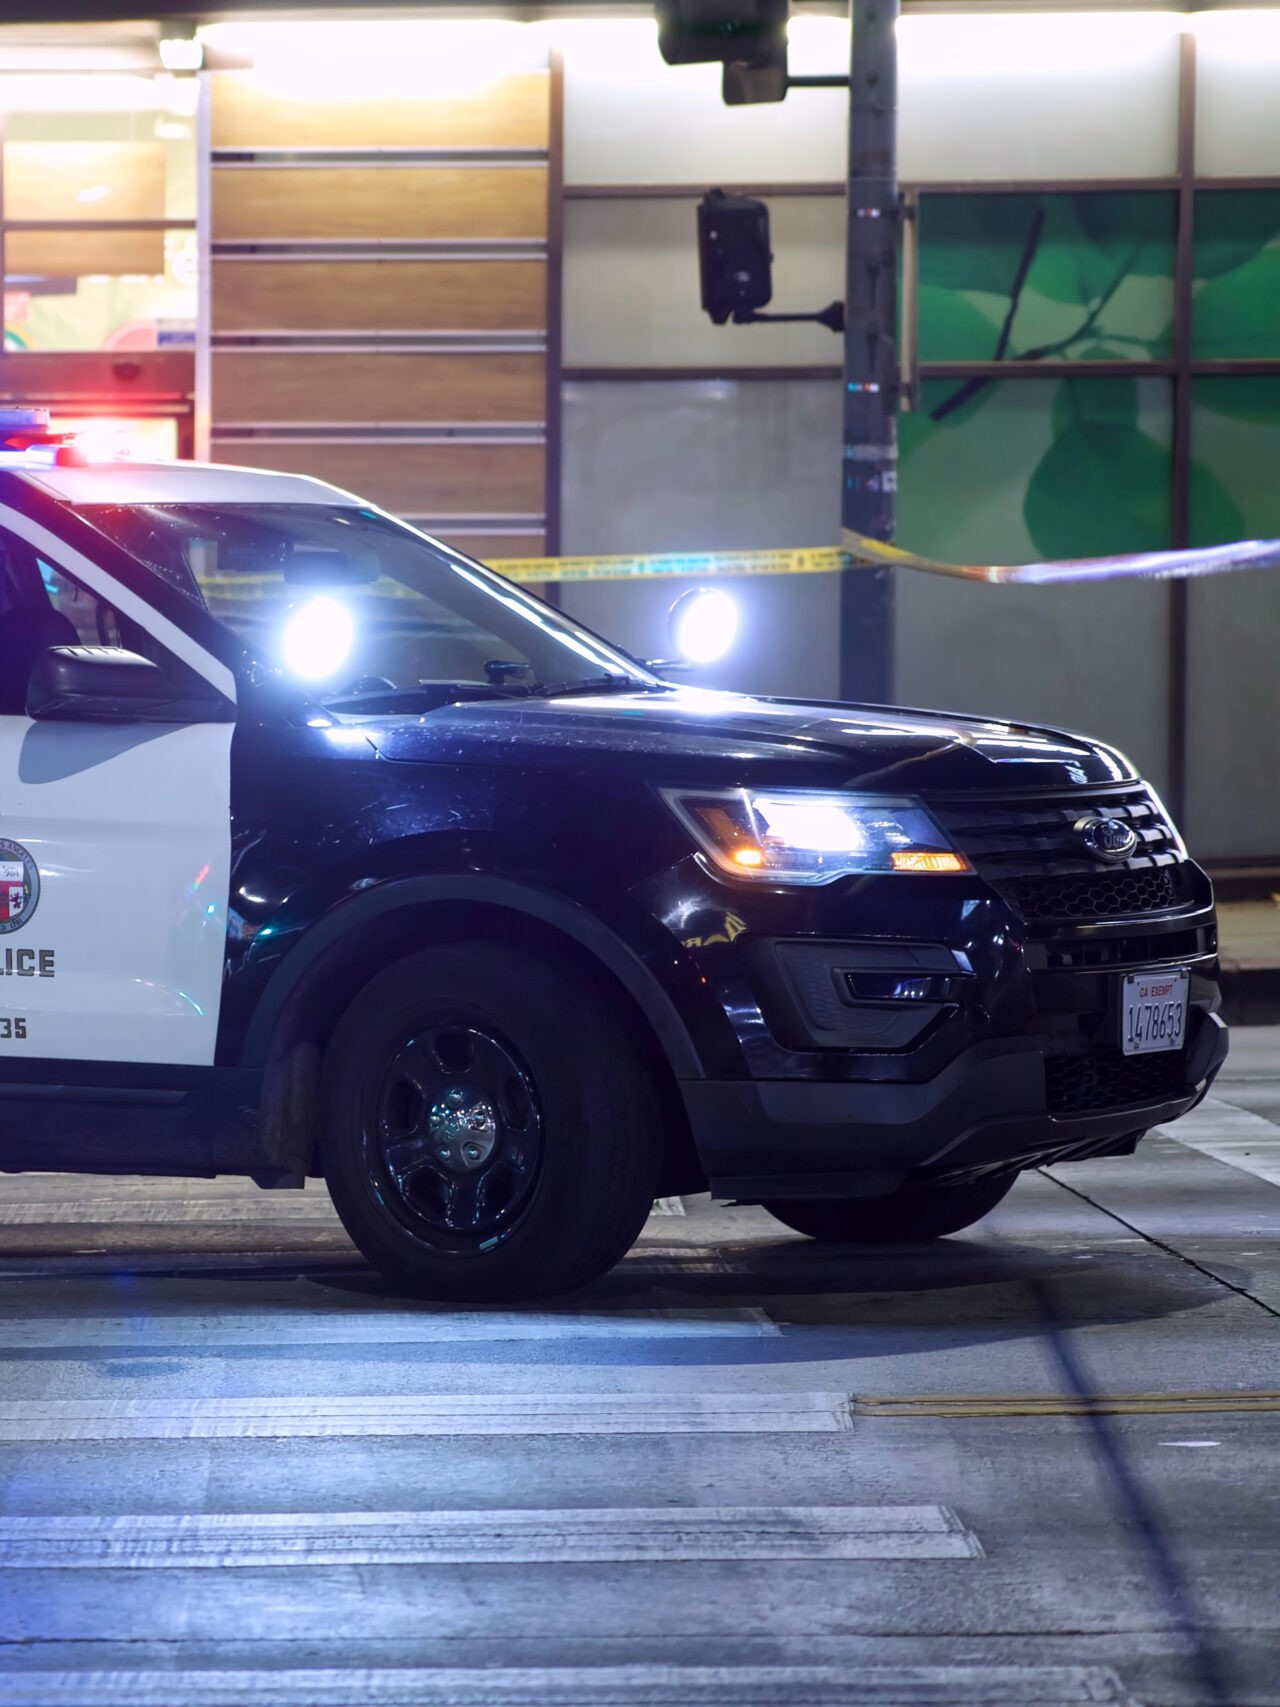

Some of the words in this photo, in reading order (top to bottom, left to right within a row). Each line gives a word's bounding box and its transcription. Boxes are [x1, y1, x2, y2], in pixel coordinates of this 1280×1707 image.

[1140, 987, 1149, 998] CA
[1151, 985, 1174, 997] EXEMPT
[1128, 1001, 1183, 1041] 1478653
